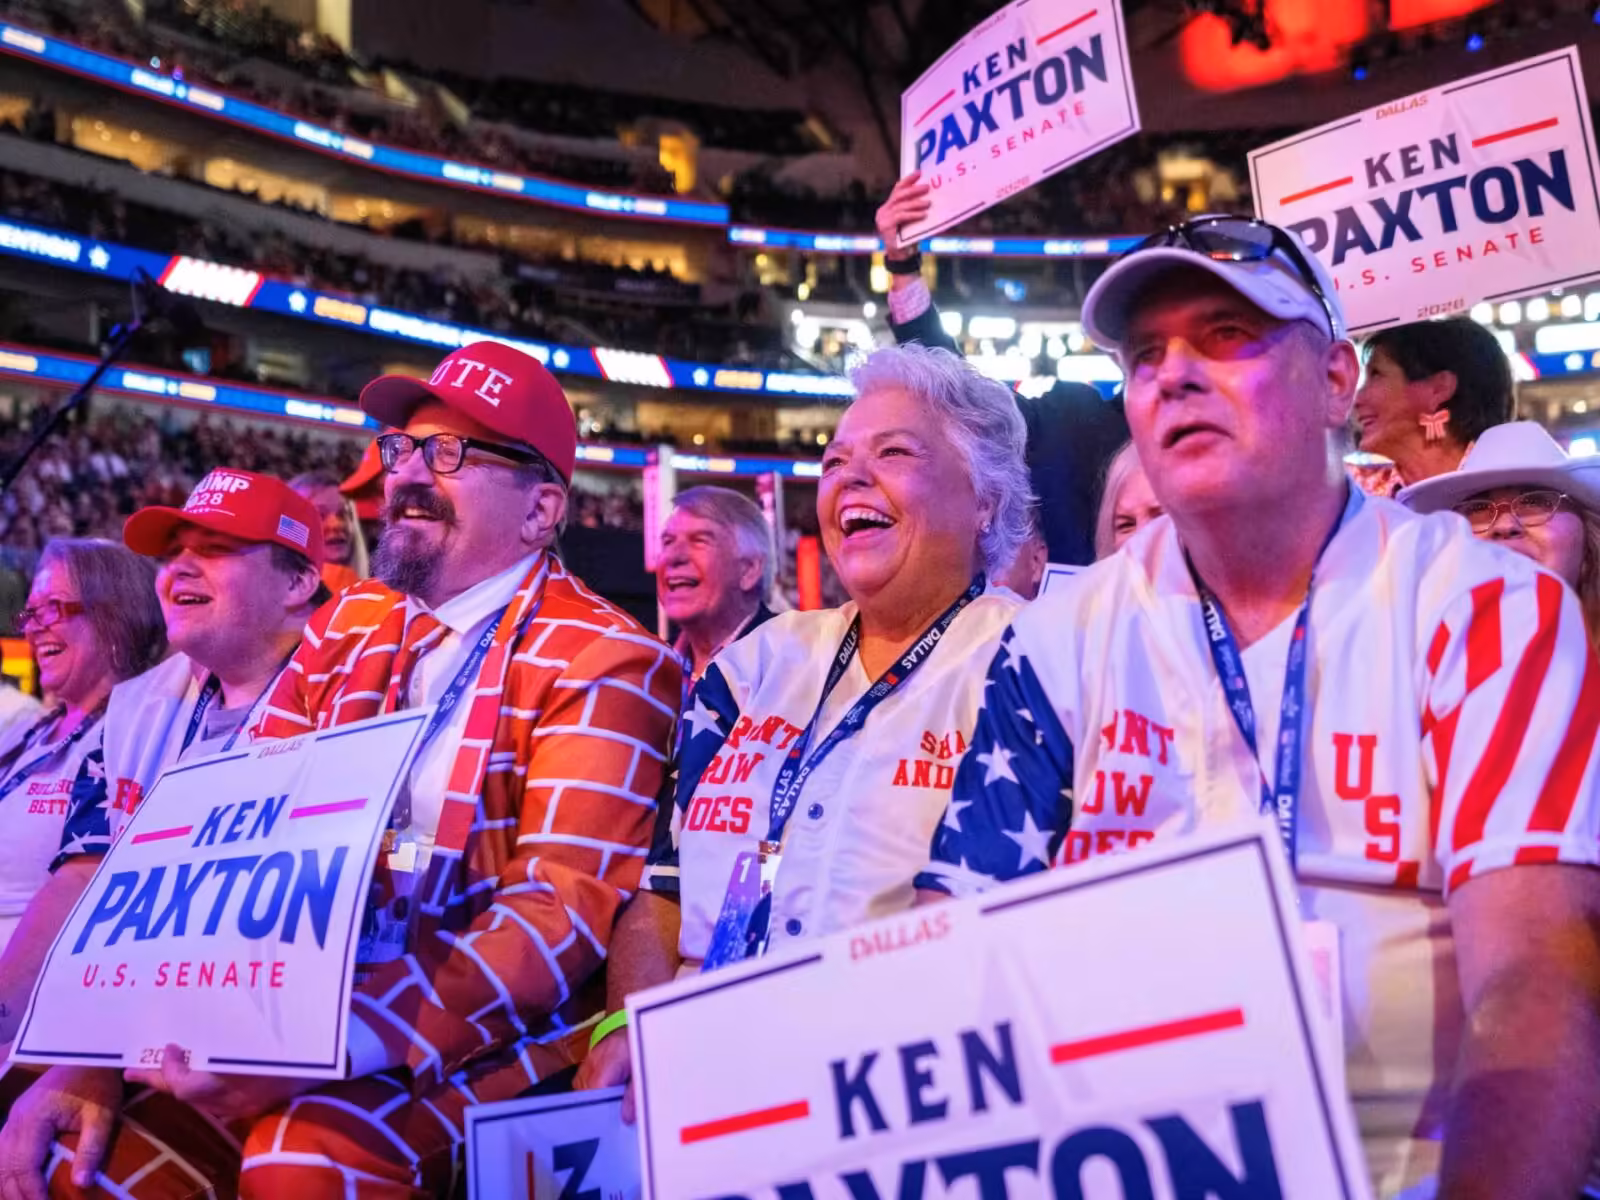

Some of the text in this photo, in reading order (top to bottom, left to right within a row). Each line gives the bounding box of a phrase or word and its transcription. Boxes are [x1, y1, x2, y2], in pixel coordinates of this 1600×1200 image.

[962, 37, 1028, 95] KEN
[914, 33, 1108, 172] PAXTON
[1376, 96, 1429, 121] DALLAS
[930, 101, 1086, 190] U.S. SENATE
[1364, 132, 1461, 189] KEN
[1283, 148, 1577, 268] PAXTON
[1411, 227, 1545, 274] SENATE
[429, 357, 513, 407] OTE
[901, 626, 942, 670] DALLAS
[681, 796, 753, 834] OES
[777, 766, 810, 818] DALLAS
[192, 793, 290, 849] KEN
[739, 857, 753, 884] 1
[70, 846, 349, 955] PAXTON
[850, 910, 953, 963] DALLAS
[82, 961, 286, 989] U.S. SENATE
[140, 1048, 192, 1064] 206
[829, 1016, 1024, 1141] KEN
